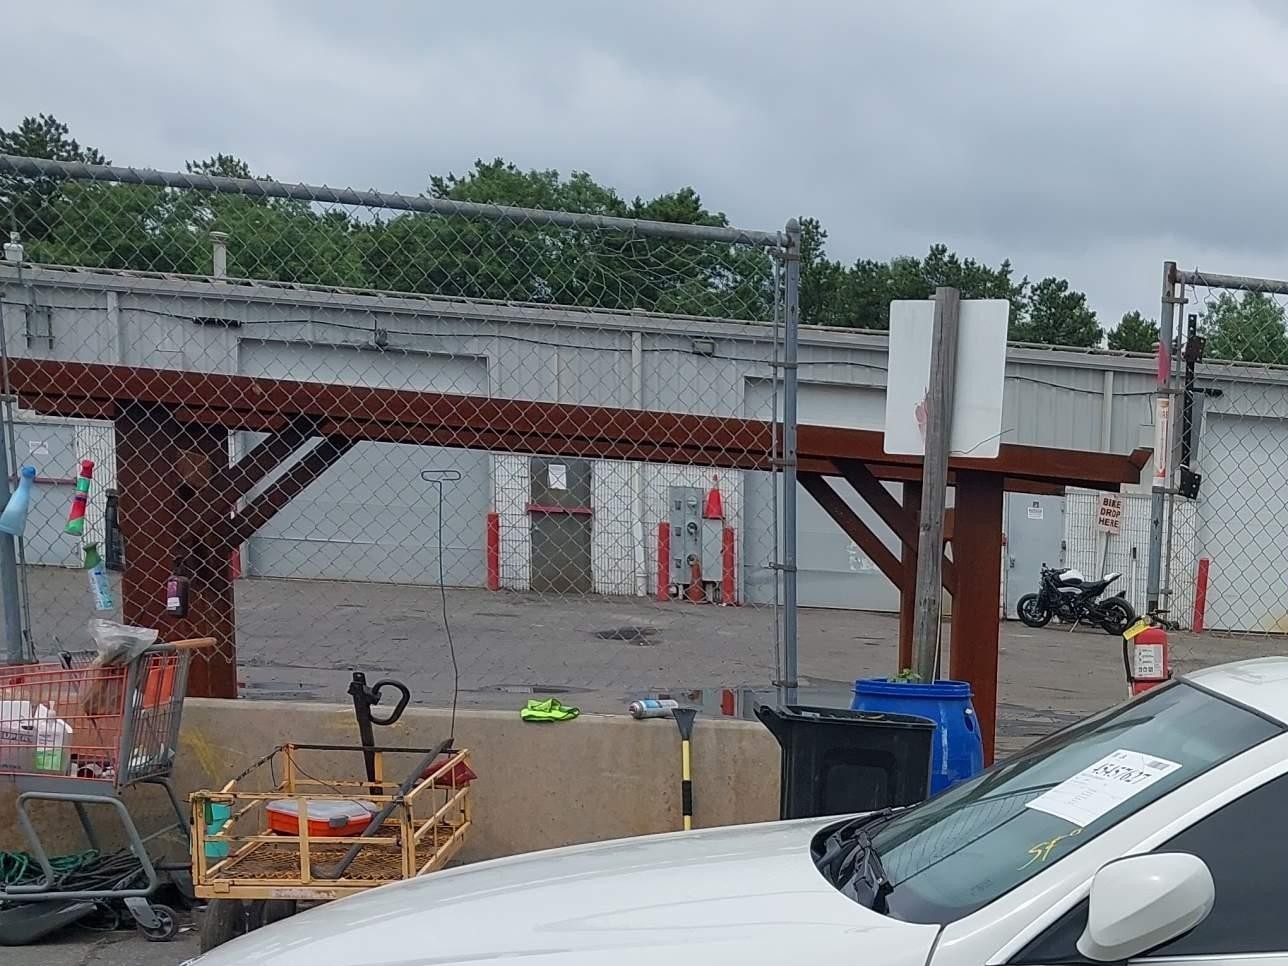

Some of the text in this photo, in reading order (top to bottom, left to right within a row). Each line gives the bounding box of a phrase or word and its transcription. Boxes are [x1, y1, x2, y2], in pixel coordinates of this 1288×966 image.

[1103, 497, 1122, 509] BIKE
[1100, 507, 1121, 519] DROP
[1098, 517, 1120, 528] HERE
